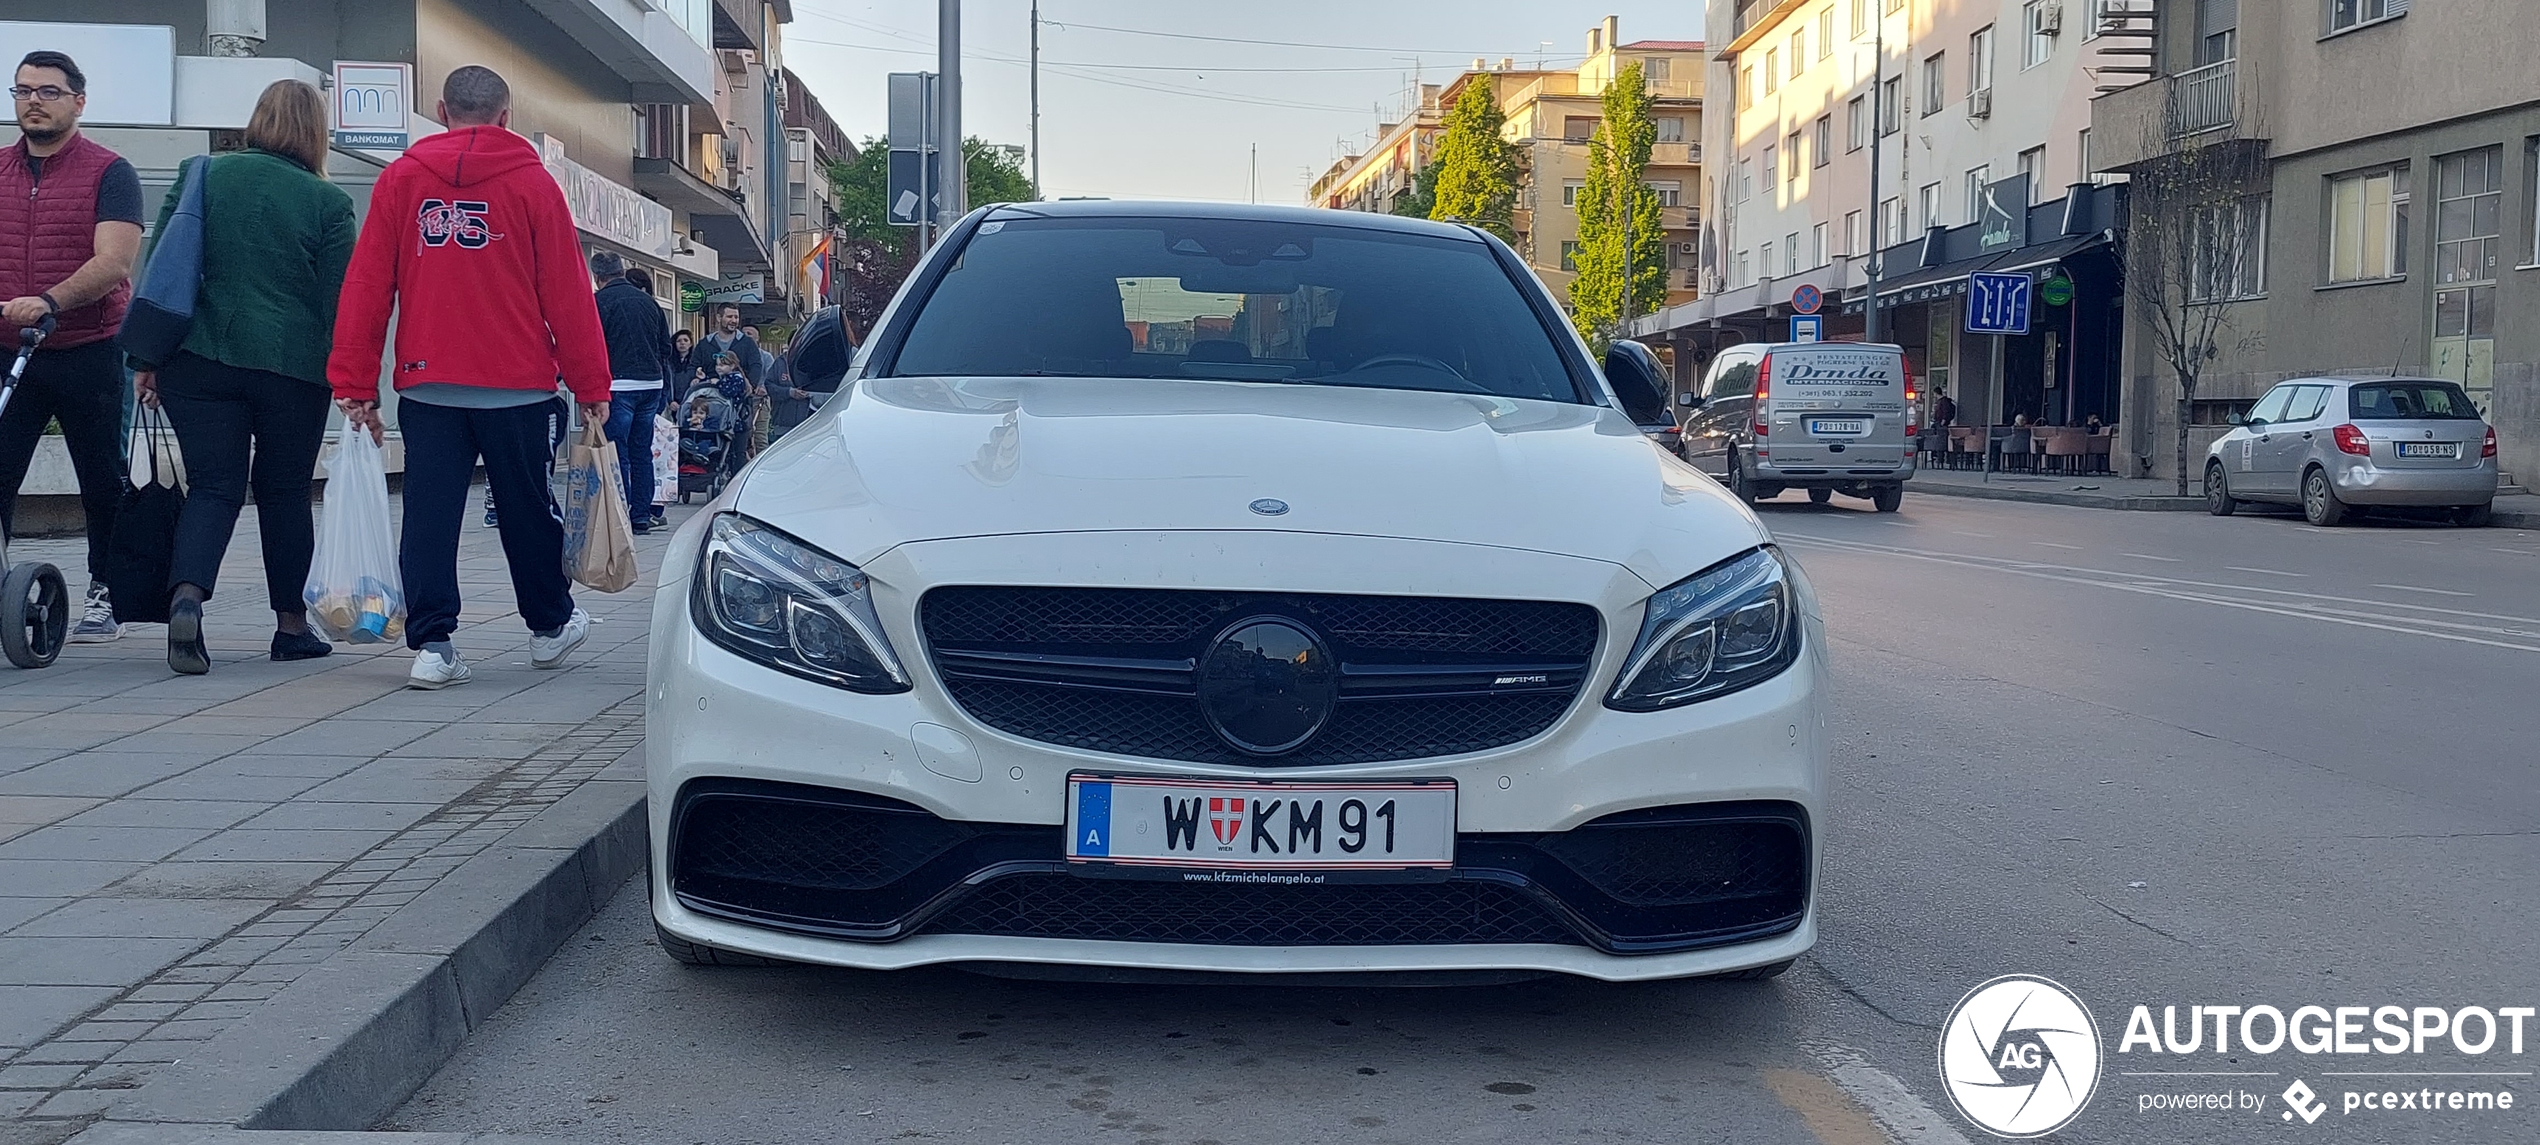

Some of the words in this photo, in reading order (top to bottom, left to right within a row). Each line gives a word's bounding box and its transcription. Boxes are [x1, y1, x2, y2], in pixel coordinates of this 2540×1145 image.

[344, 134, 399, 145] BANKOMAT
[705, 281, 760, 297] GRAČKE
[1786, 364, 1888, 380] Drnda
[1163, 795, 1202, 851] W
[1085, 828, 1101, 846] A
[1183, 871, 1325, 884] www.kfzmichelangelo.at
